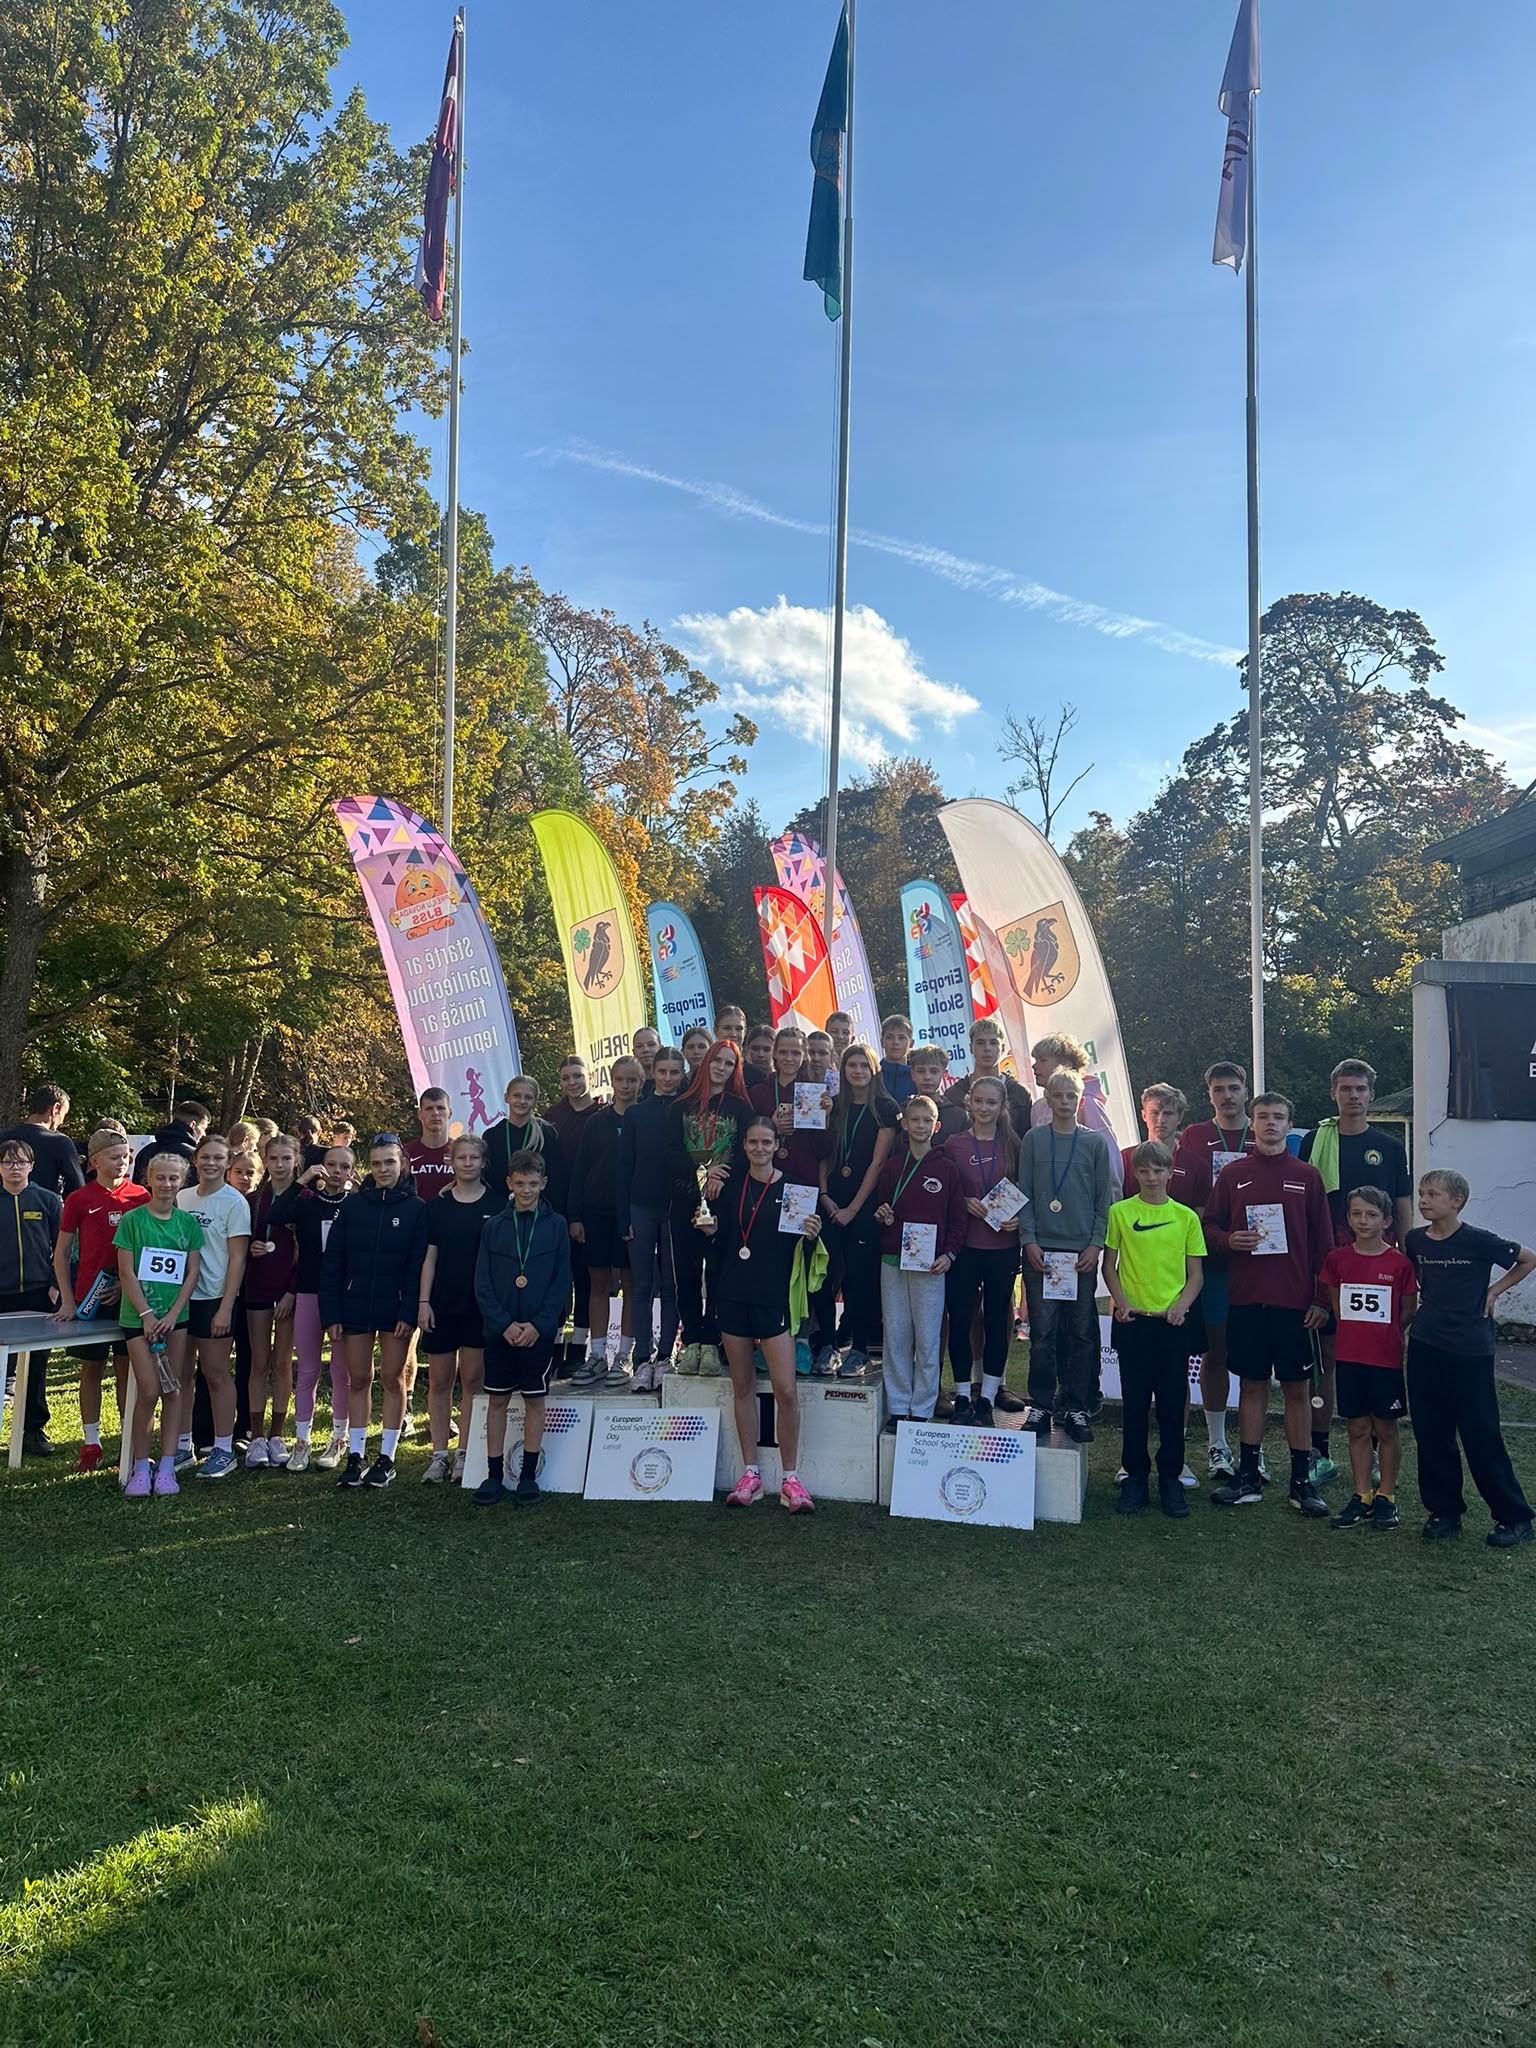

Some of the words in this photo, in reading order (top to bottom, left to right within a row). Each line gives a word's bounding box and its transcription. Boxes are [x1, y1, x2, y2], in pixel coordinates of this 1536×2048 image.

[411, 1164, 455, 1175] LATVIA
[150, 1256, 176, 1274] 59
[1416, 1254, 1472, 1268] Champion
[1350, 1293, 1379, 1313] 55
[825, 1390, 867, 1400] PESMENPOL
[612, 1415, 643, 1424] European
[633, 1424, 651, 1432] Sport
[606, 1433, 620, 1441] Day
[916, 1429, 951, 1439] European
[914, 1438, 939, 1447] School
[940, 1440, 960, 1449] Sport
[911, 1446, 926, 1456] Day
